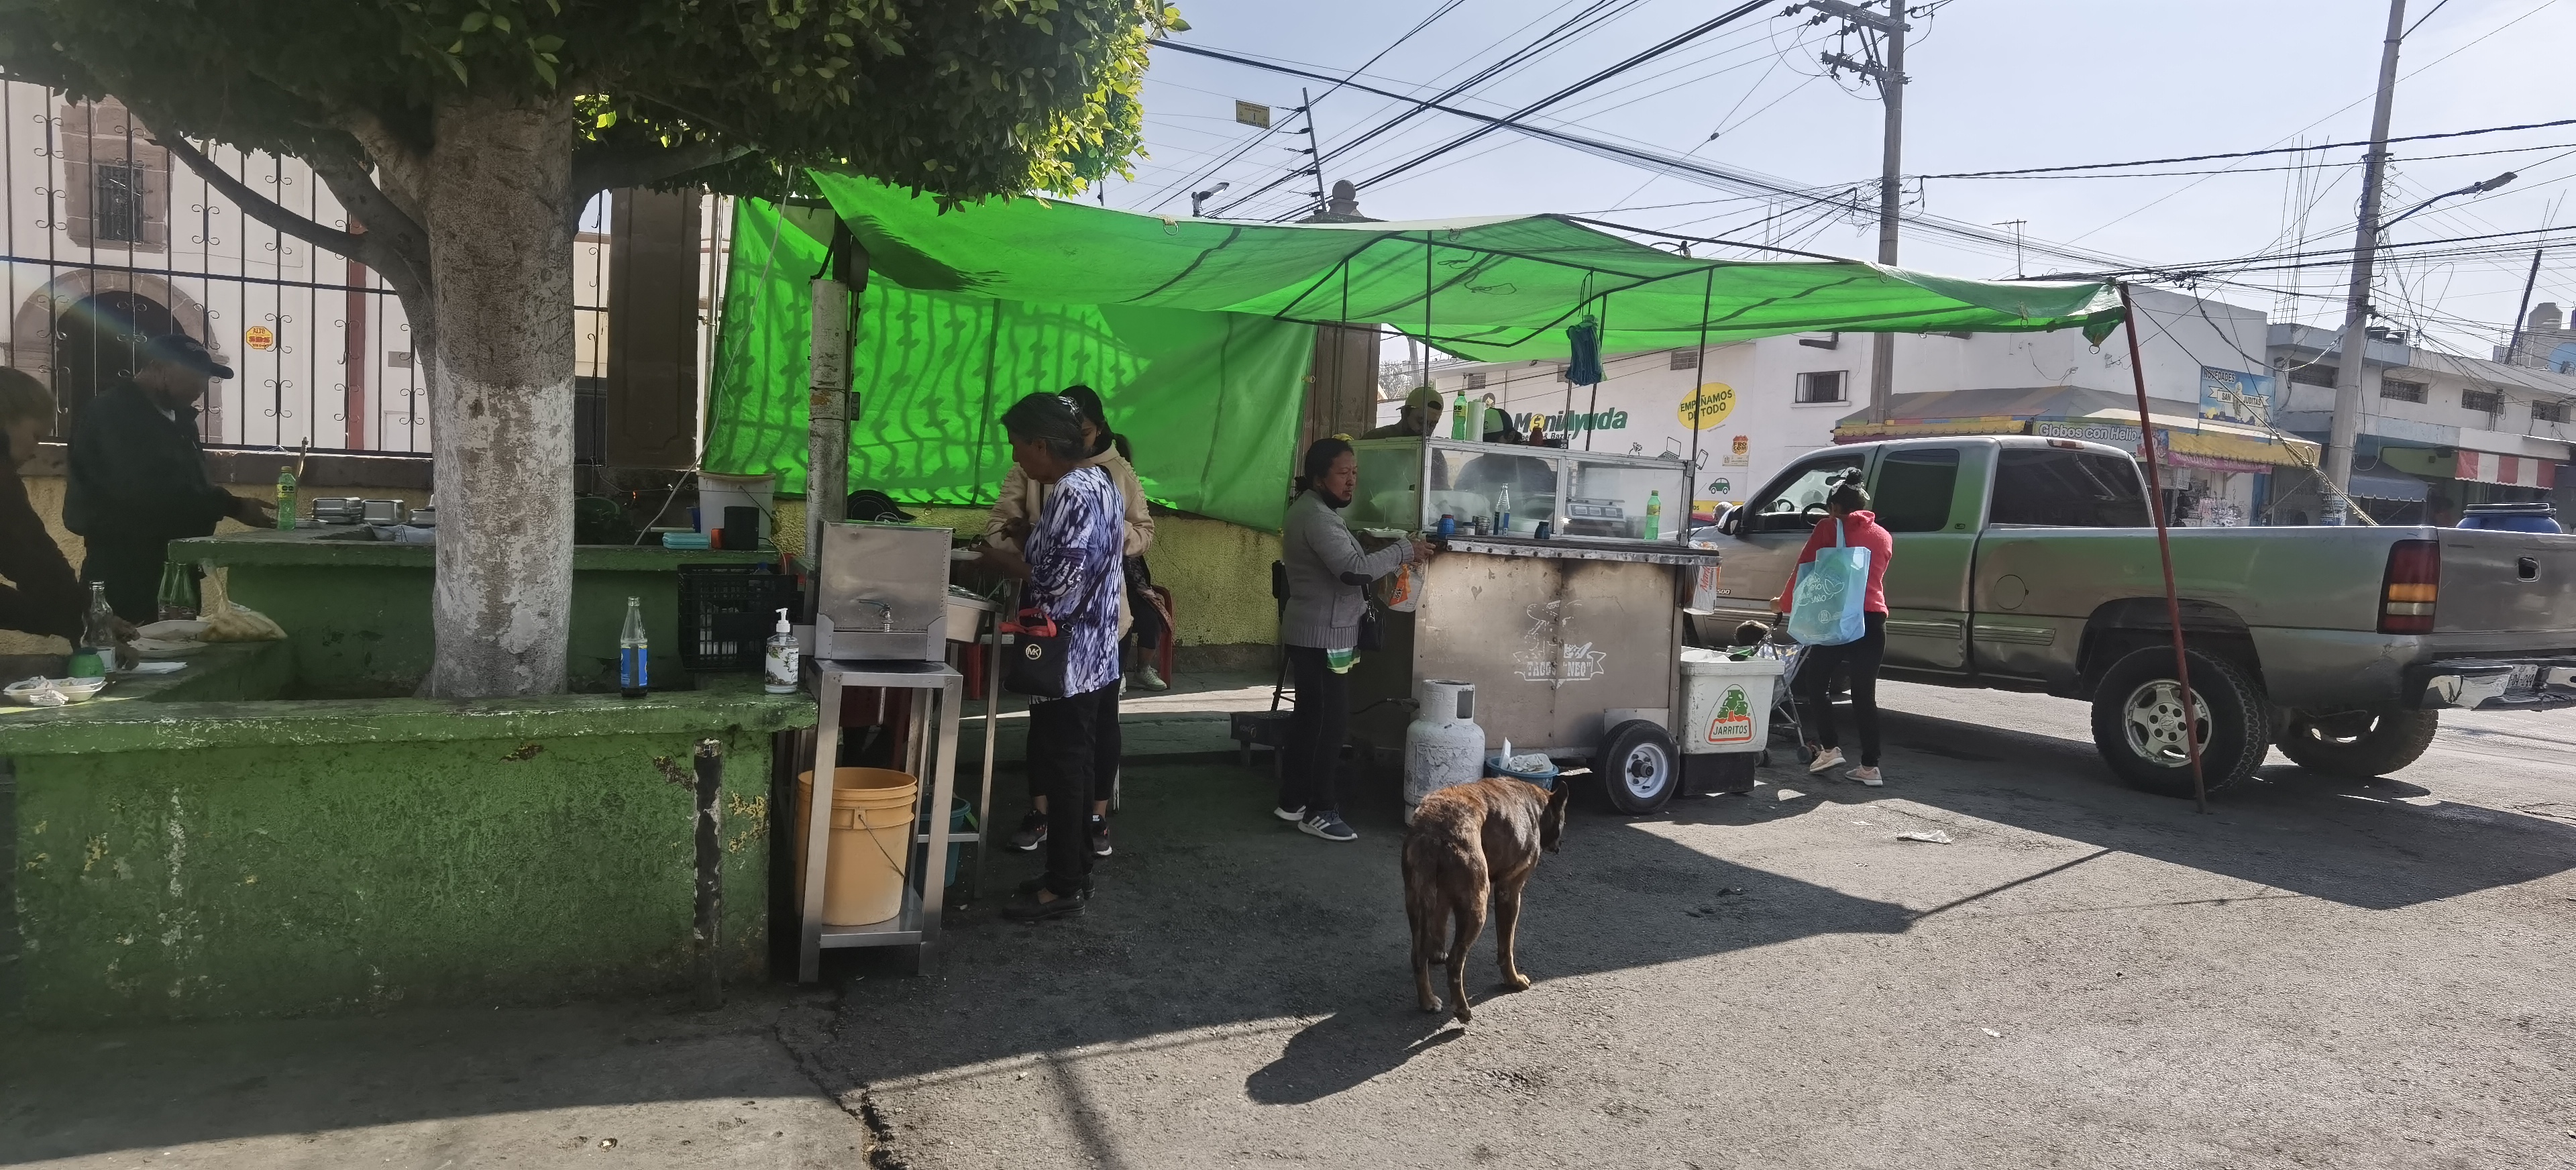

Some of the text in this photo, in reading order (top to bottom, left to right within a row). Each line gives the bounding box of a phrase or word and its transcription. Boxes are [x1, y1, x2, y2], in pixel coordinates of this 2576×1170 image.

[2203, 369, 2235, 383] NOVEDADES
[1680, 390, 1733, 412] EMPÑAMOS
[2222, 392, 2261, 406] SAN JUDITAS
[1701, 402, 1726, 417] TODO
[2039, 423, 2082, 438] Globos
[2084, 427, 2108, 439] con
[1027, 647, 1040, 656] MK
[1527, 661, 1557, 676] TACOS
[1713, 725, 1748, 735] JARRITOS
